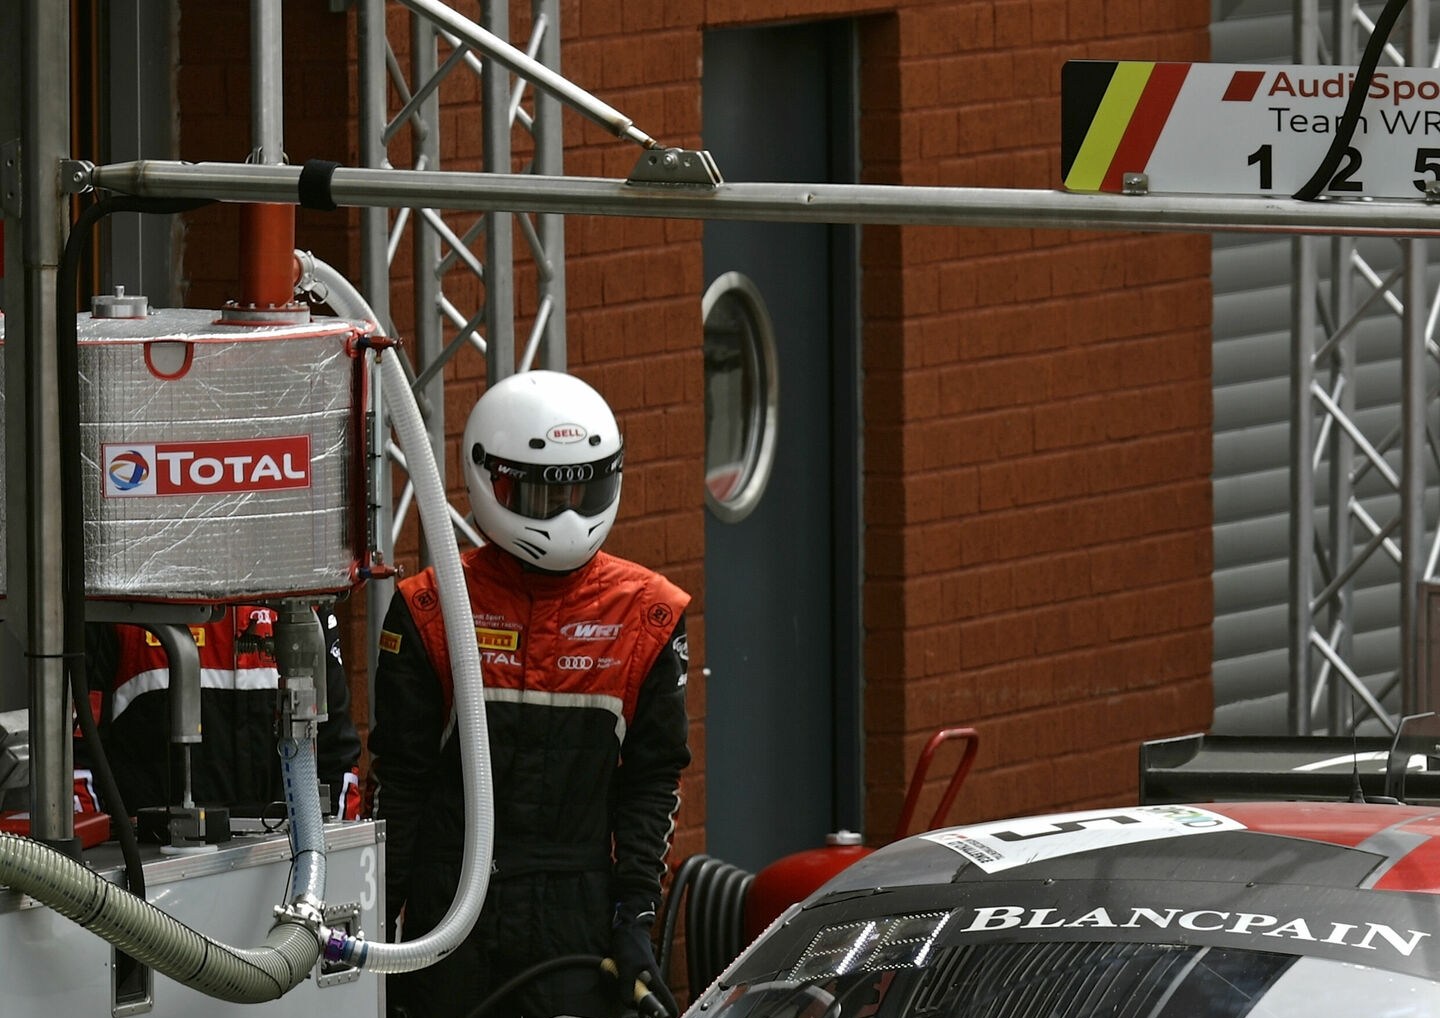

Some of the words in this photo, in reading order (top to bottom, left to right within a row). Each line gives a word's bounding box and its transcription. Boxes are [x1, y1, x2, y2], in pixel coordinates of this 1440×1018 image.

[1268, 71, 1355, 99] Audi
[1268, 107, 1368, 134] Team
[1247, 144, 1274, 191] 1
[1328, 146, 1364, 192] 2
[553, 428, 582, 438] BELL
[156, 450, 306, 487] TOTAL
[498, 464, 527, 479] WRT
[480, 651, 522, 666] TAL
[359, 846, 377, 911] 3
[959, 905, 1432, 957] BLANCPAIN
